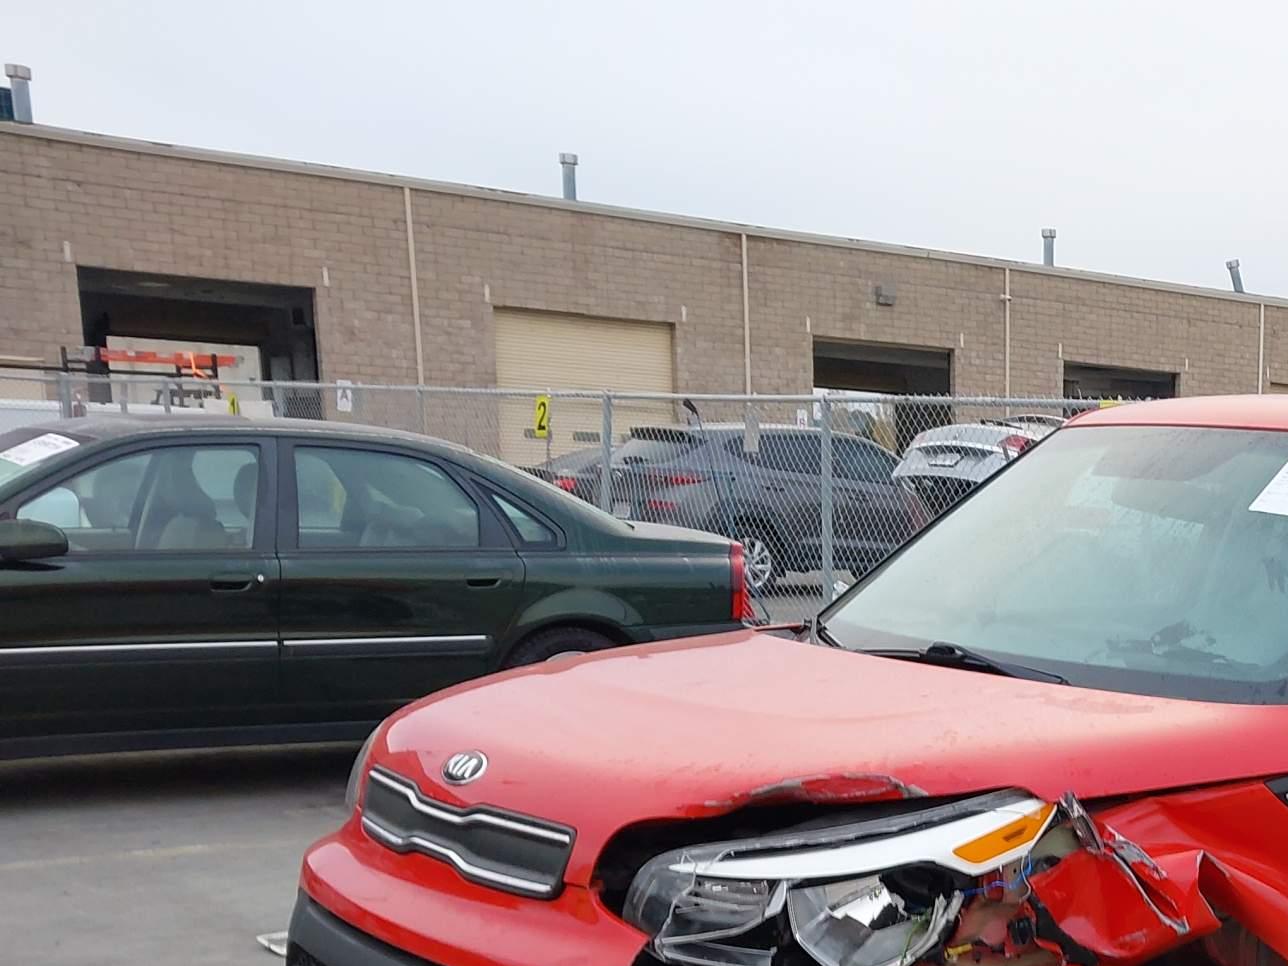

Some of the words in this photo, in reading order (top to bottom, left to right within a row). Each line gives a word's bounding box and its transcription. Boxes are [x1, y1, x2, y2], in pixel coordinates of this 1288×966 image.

[339, 388, 349, 401] A
[537, 401, 547, 431] 2
[444, 752, 479, 779] KIA
